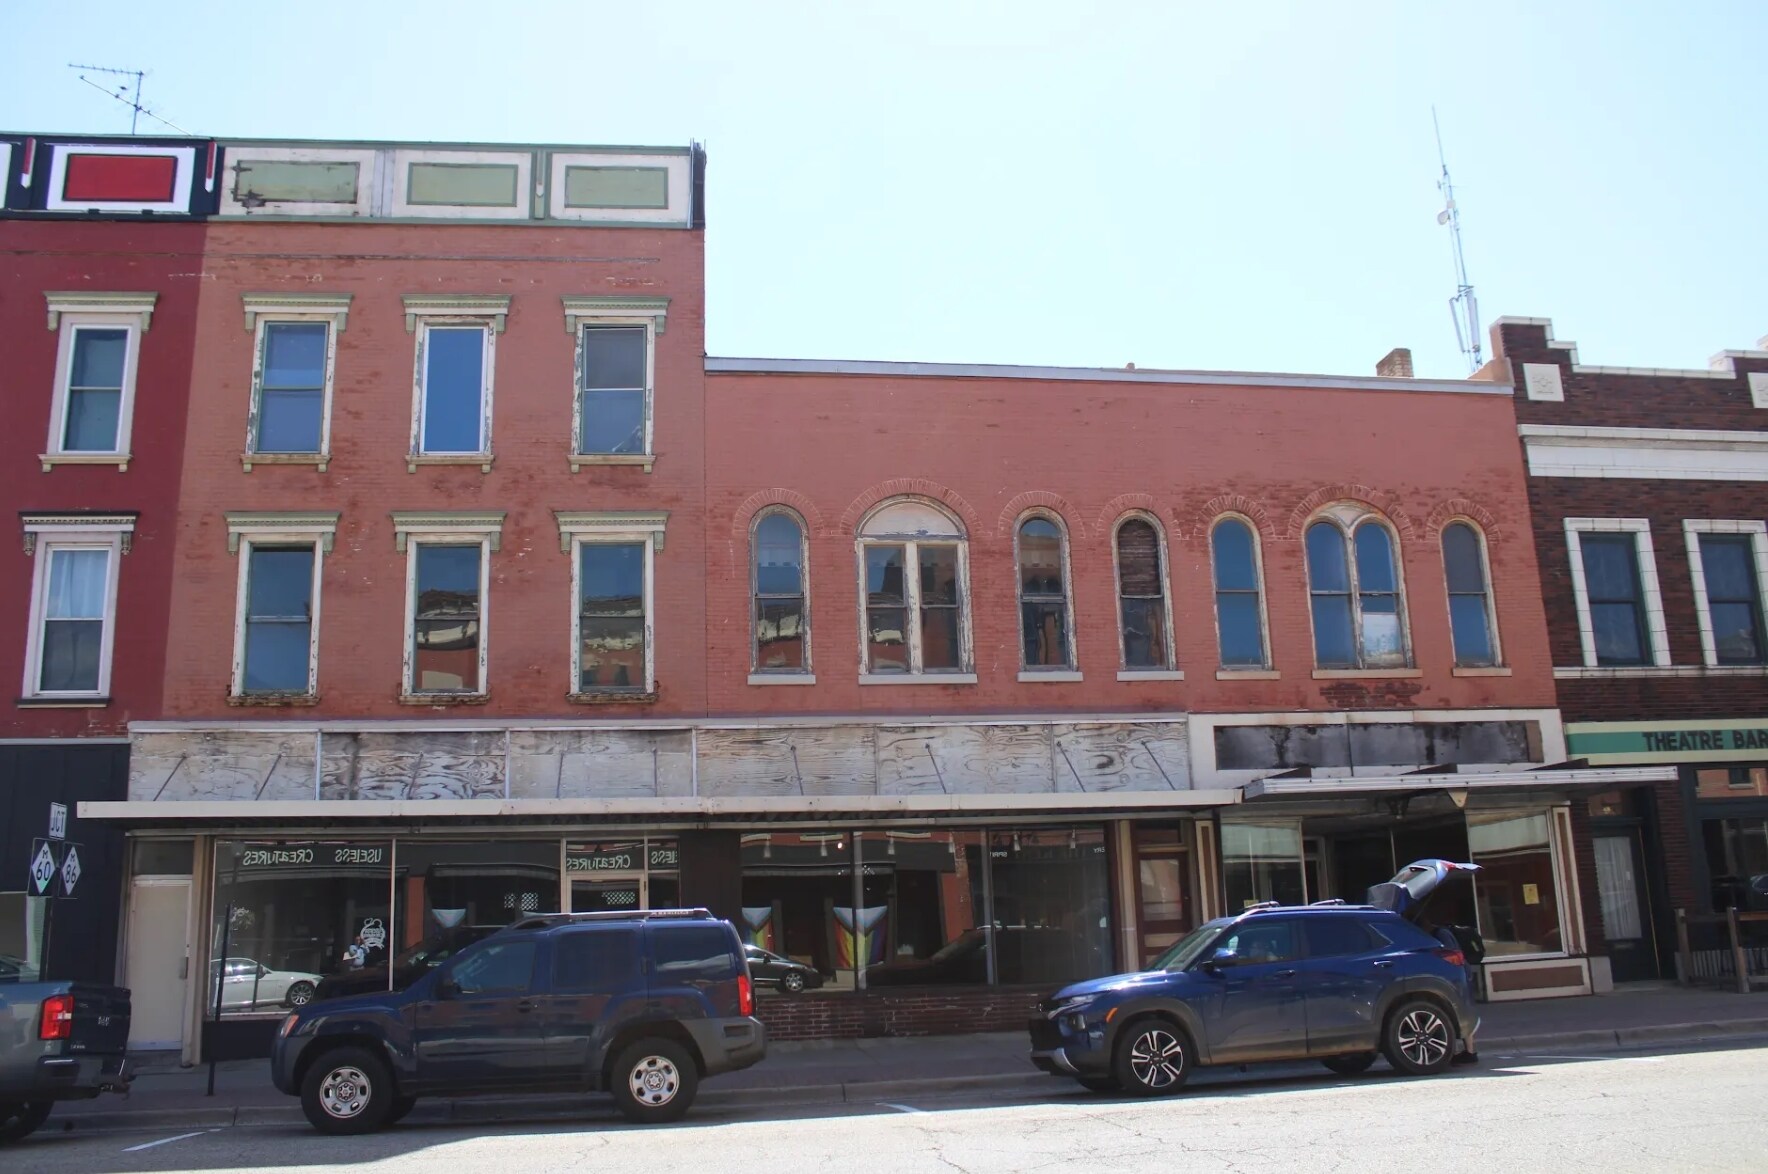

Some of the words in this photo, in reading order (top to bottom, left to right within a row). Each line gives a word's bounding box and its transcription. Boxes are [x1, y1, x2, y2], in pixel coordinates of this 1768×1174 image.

[1642, 730, 1723, 752] THEATRE
[1732, 728, 1768, 750] BAR
[51, 809, 65, 833] JCT
[42, 849, 48, 859] M
[70, 853, 76, 862] M
[36, 861, 51, 881] 60
[65, 864, 76, 884] 86
